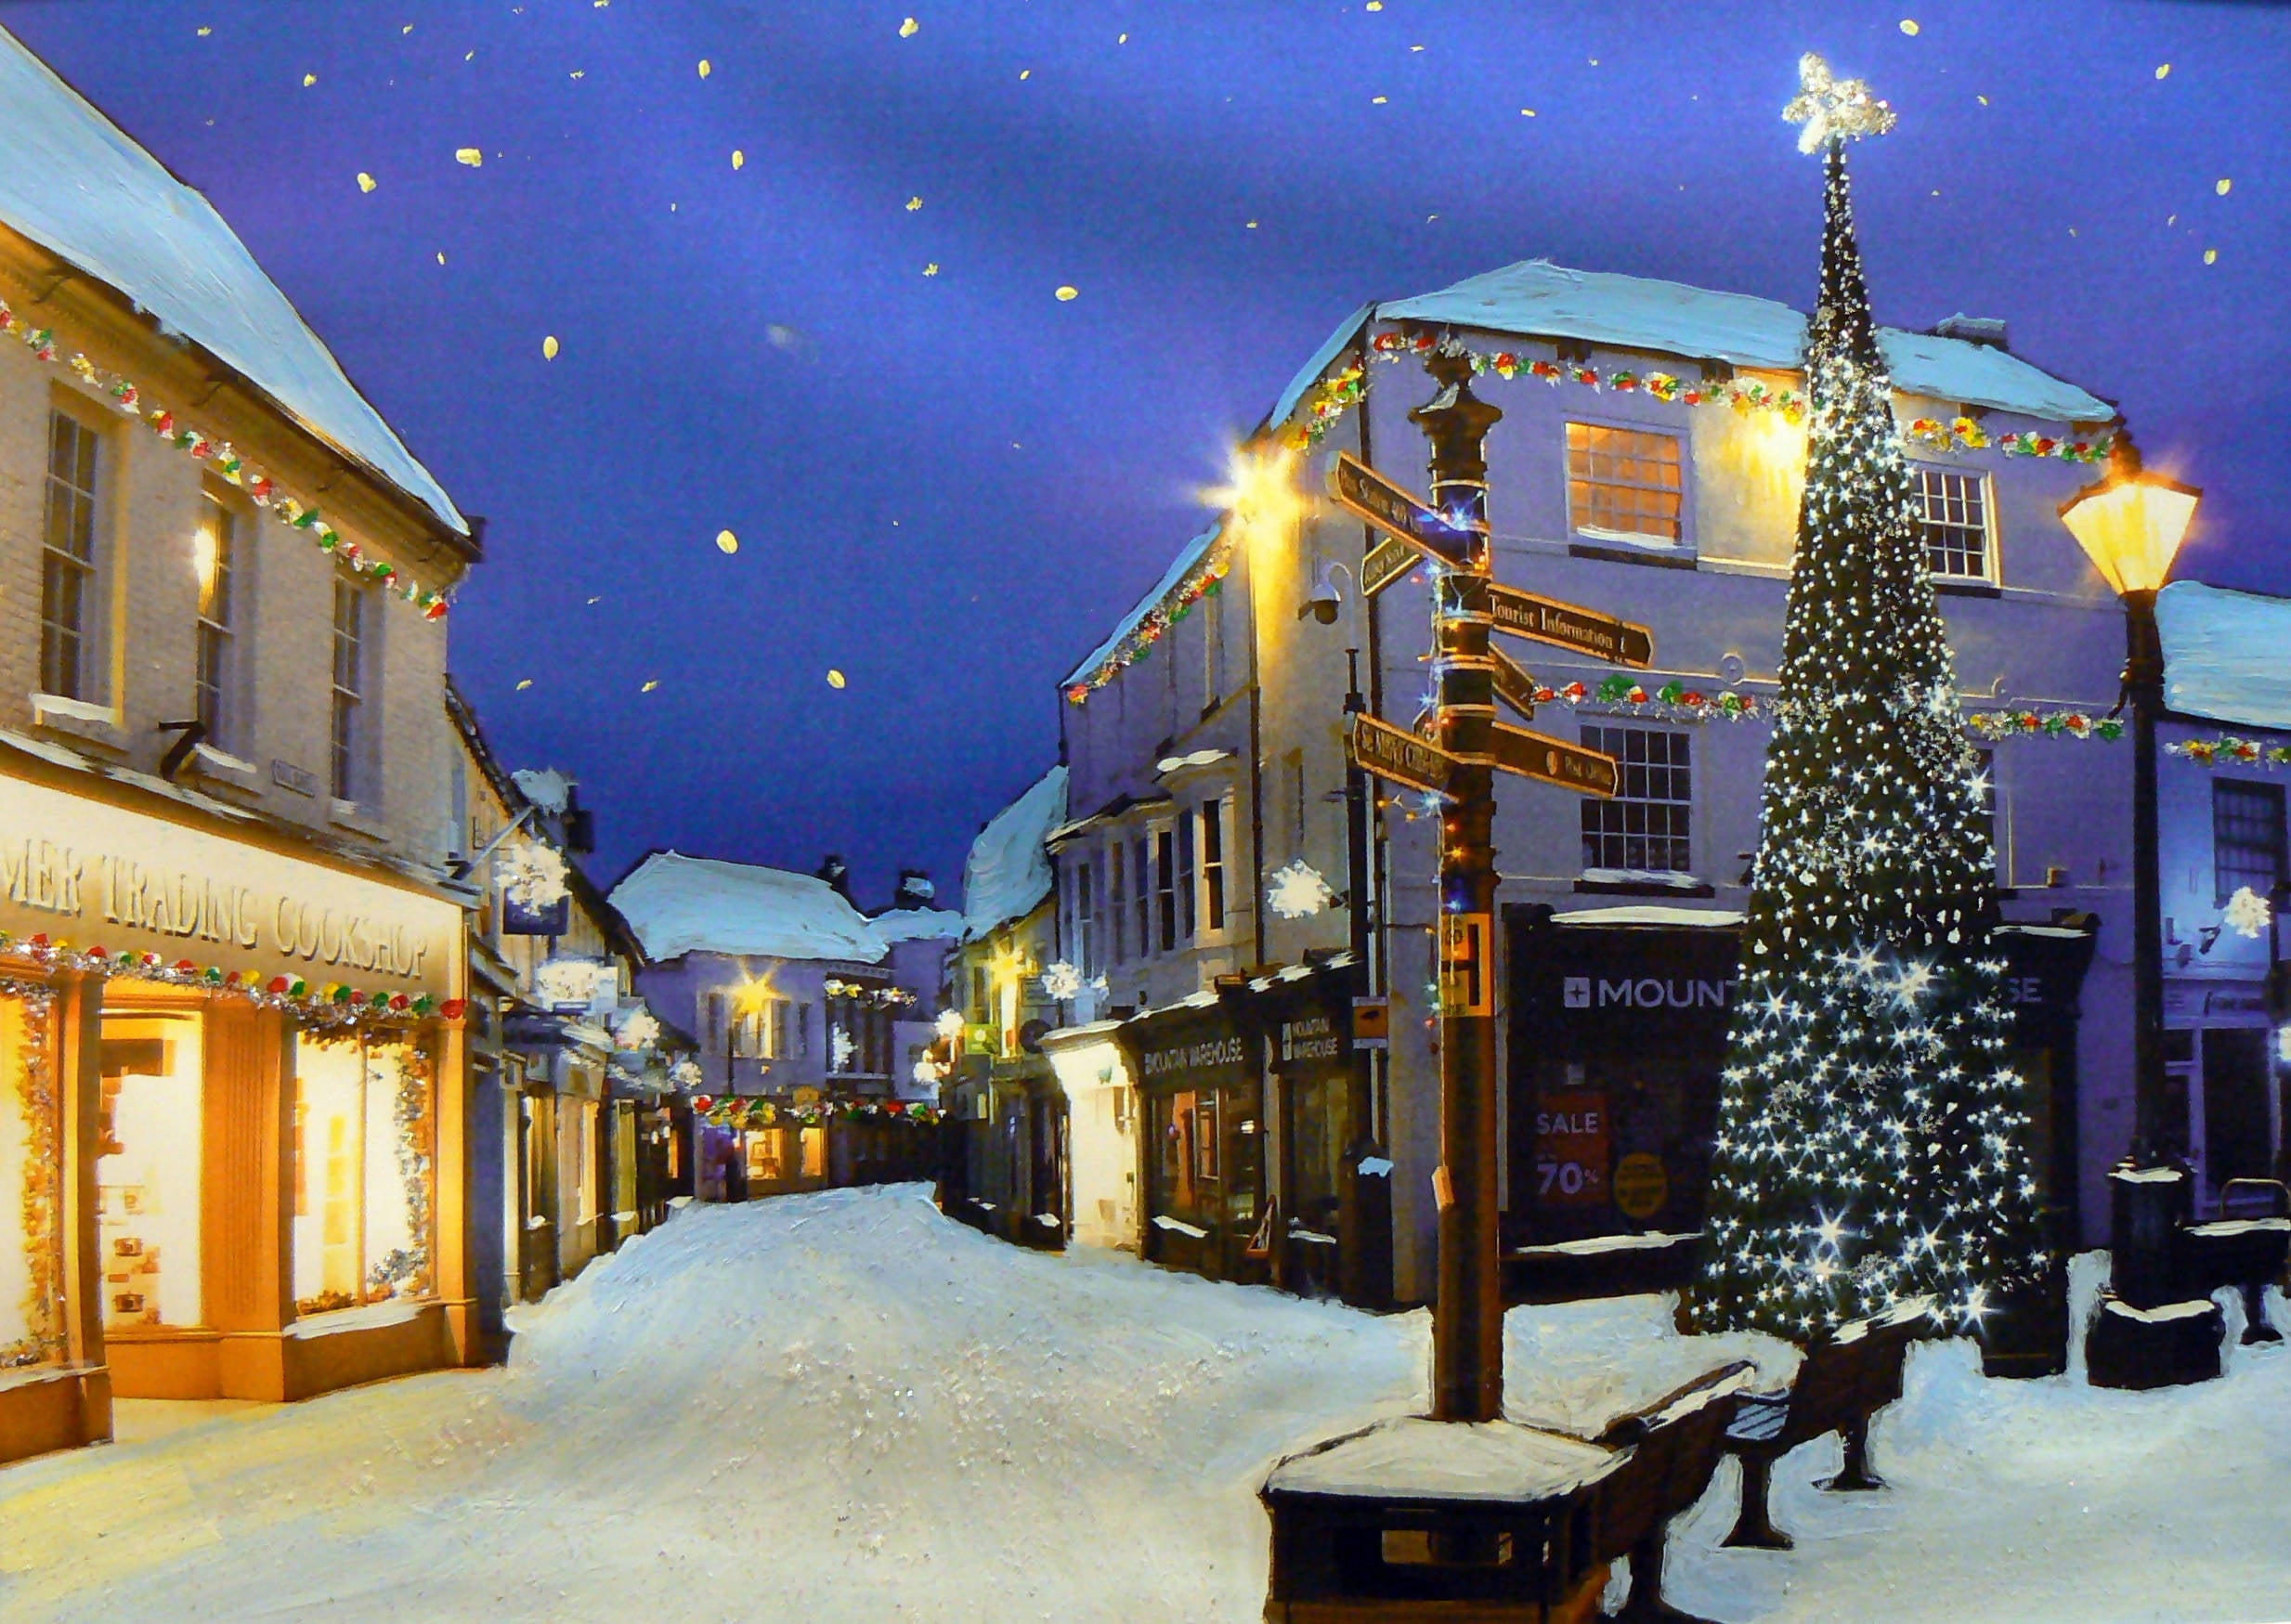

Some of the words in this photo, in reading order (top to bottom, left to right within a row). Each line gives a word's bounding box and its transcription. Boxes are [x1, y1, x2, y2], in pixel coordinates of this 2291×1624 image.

[1488, 593, 1535, 627] Tourist
[1541, 605, 1613, 650] Information
[99, 853, 259, 951] TRADING
[276, 895, 428, 981] COOKSHOP
[1537, 1112, 1598, 1135] SALE
